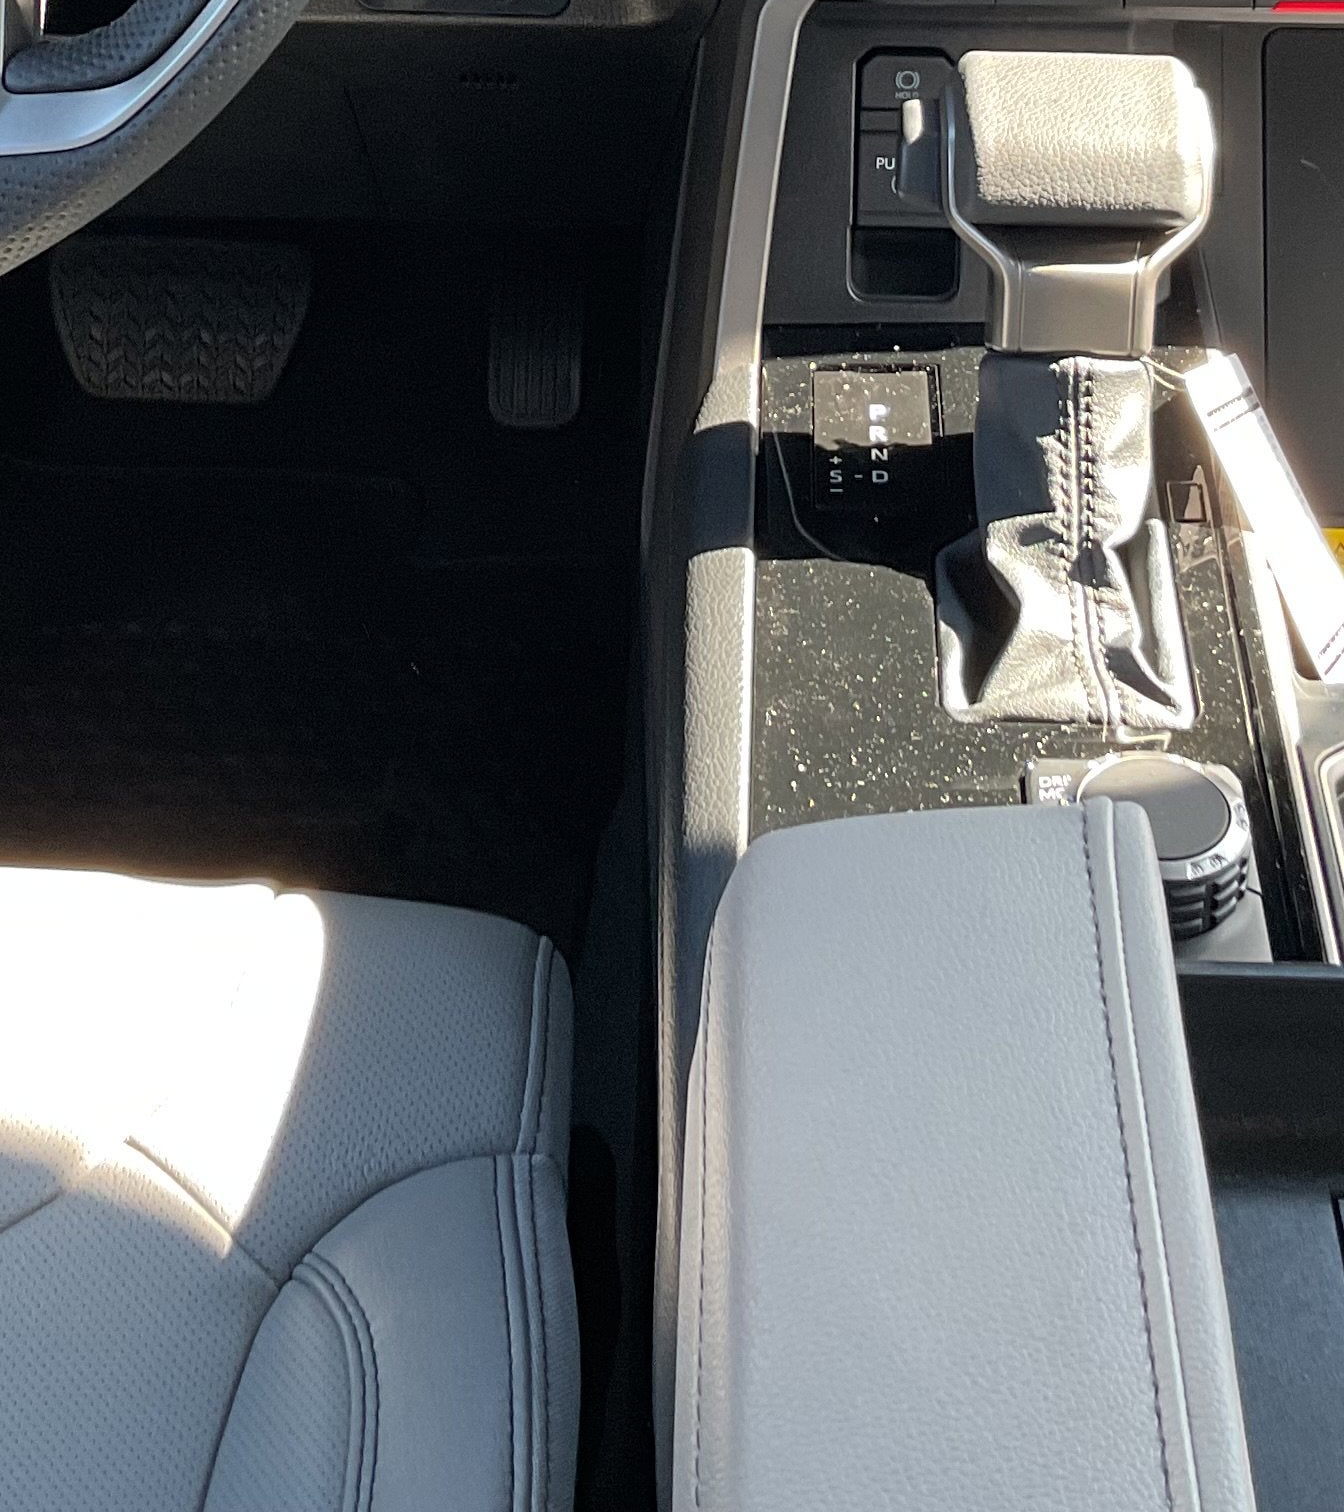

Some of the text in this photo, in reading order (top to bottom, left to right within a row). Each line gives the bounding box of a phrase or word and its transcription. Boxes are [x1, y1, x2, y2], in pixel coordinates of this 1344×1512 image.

[875, 156, 896, 171] PU
[868, 403, 888, 421] P
[868, 425, 889, 443] R
[870, 448, 889, 462] N
[829, 469, 890, 484] S D
[1038, 775, 1072, 788] DRI
